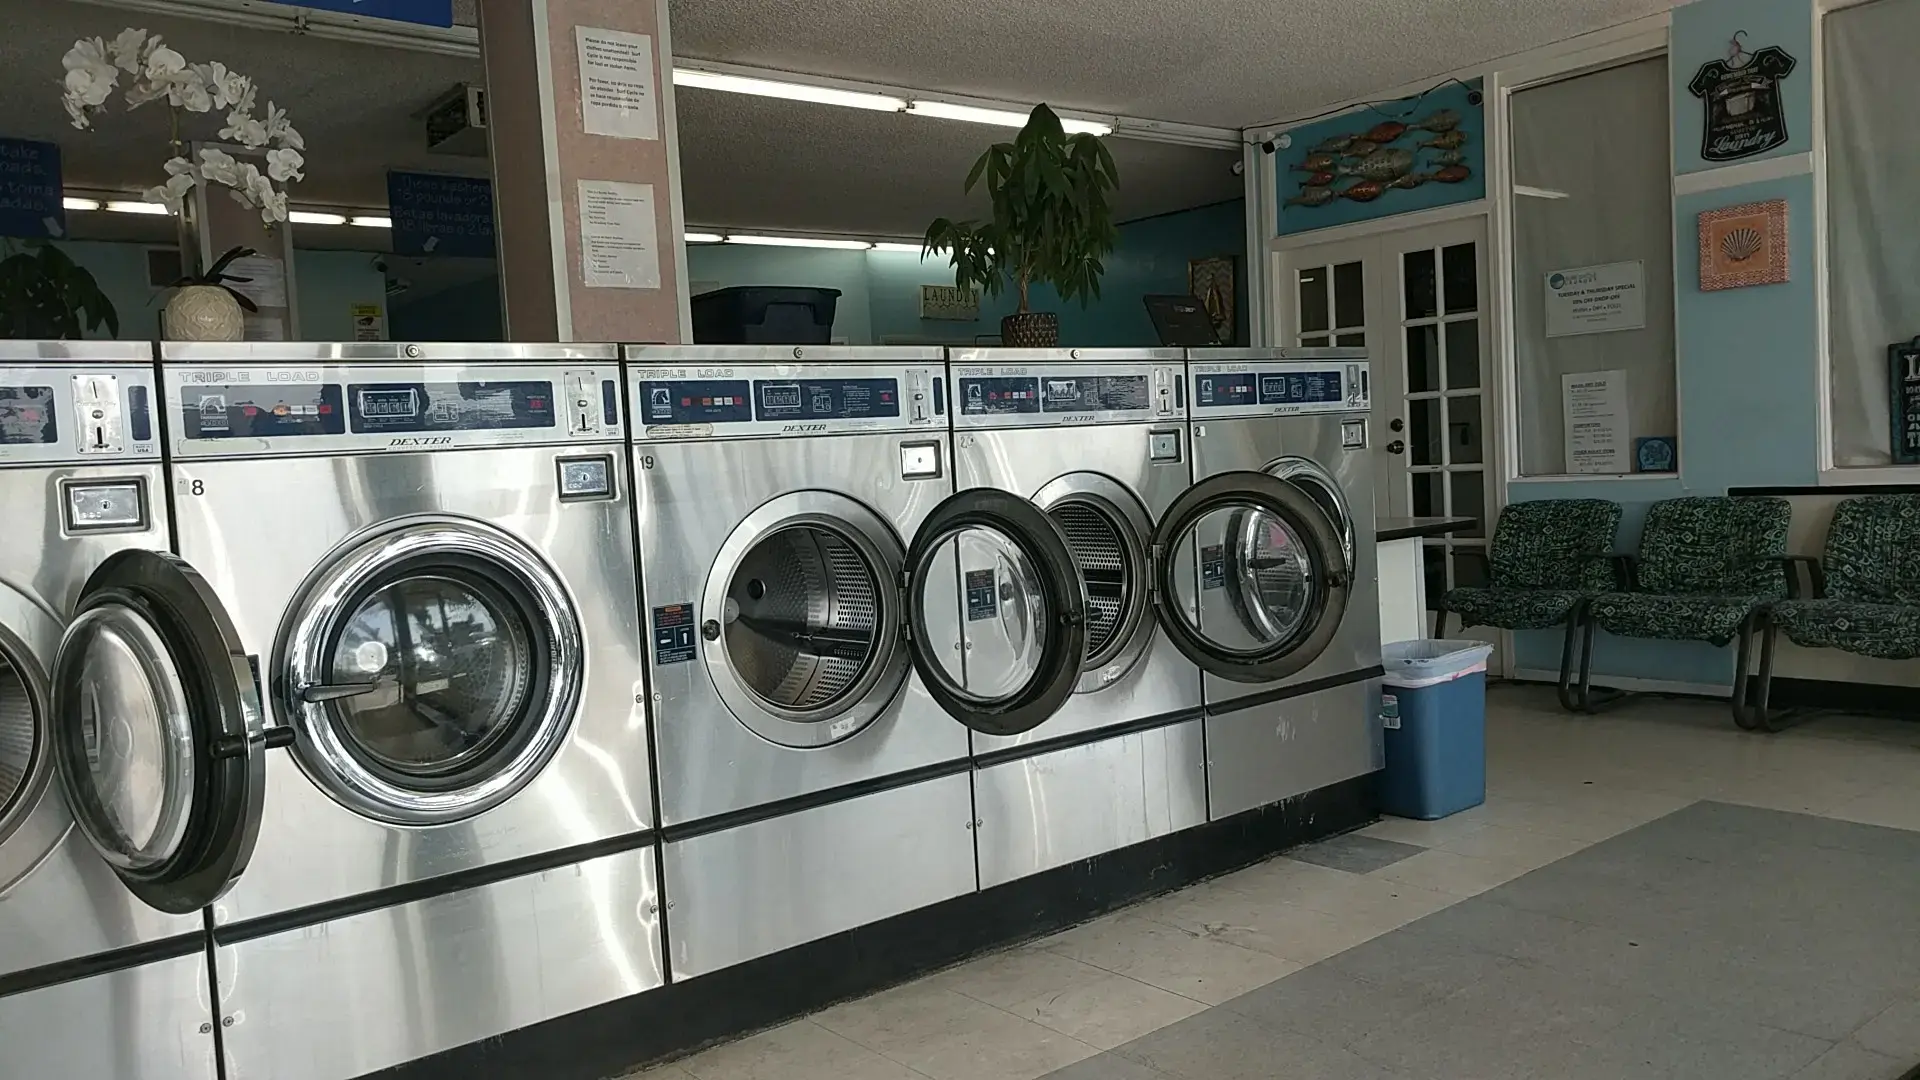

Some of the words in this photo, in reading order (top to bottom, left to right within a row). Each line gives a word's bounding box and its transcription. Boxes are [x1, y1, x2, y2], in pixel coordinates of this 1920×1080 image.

[1708, 129, 1776, 154] Laundry
[1558, 290, 1580, 298] TUESDAY
[1586, 286, 1614, 294] THURSDAY
[1615, 283, 1636, 291] SPECIAL
[957, 367, 994, 376] TRIPLE
[1000, 367, 1028, 376] LOAD
[1194, 365, 1222, 373] TRIPLE
[1903, 354, 1920, 382] L
[178, 371, 250, 383] TRIPLE
[266, 371, 319, 382] LOAD
[637, 369, 687, 379] TRIPLE
[697, 369, 734, 378] LOAD
[1061, 415, 1096, 423] DEXTER
[781, 424, 827, 432] DEXTER
[387, 436, 452, 446] DEXTER
[639, 455, 655, 470] 19
[191, 479, 205, 496] 8
